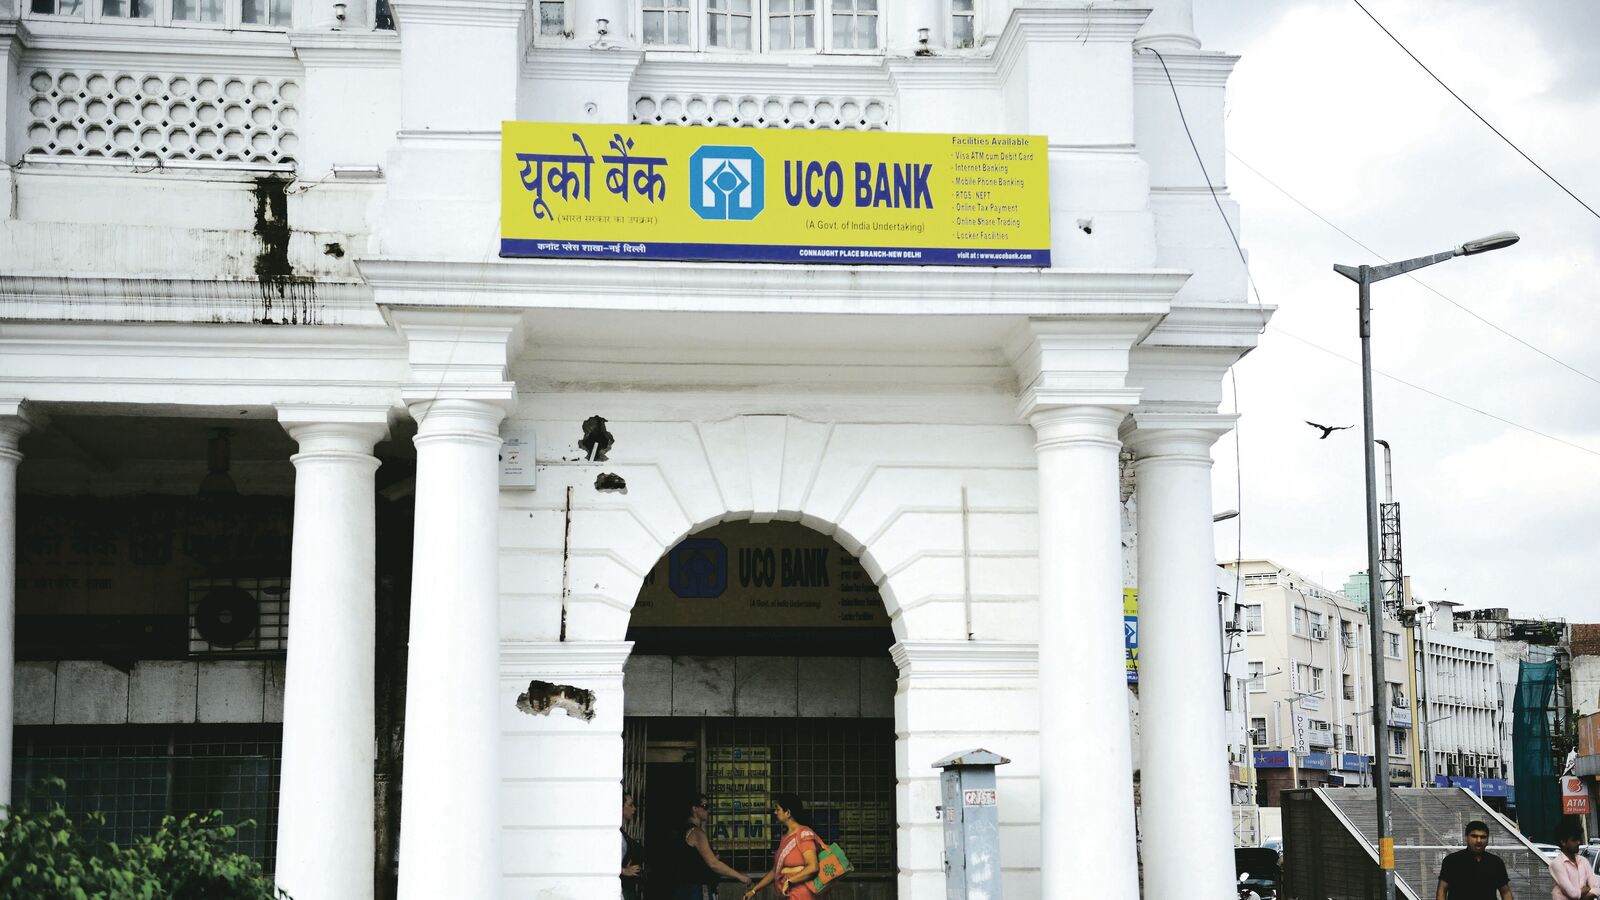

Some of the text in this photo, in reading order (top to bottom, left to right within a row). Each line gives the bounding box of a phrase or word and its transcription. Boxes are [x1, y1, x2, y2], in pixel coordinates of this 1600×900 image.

[952, 137, 1029, 146] Facilities Available
[955, 152, 969, 160] Visa
[971, 152, 984, 160] ATM
[1000, 152, 1017, 160] Debit
[1019, 152, 1033, 161] Card
[955, 164, 1008, 174] Internet Banking
[516, 133, 668, 221] यूको बैंक
[784, 160, 933, 209] UCO BANK
[955, 177, 1024, 188] Mobile Phone Banking
[976, 191, 991, 200] NEFT
[956, 203, 1018, 213] Online Tax Payment
[805, 219, 925, 233] (A Govt. of India Undertaking)
[956, 217, 1020, 228] Online Share Trading
[956, 231, 1008, 240] Locker Facilities
[623, 243, 646, 253] दिल्ली
[799, 249, 839, 257] CONNAUGHT
[839, 250, 860, 258] PLACE
[860, 250, 902, 258] BRANCH-NEW
[739, 548, 830, 587] UCO BANK
[1567, 799, 1586, 807] ATM
[714, 820, 763, 838] ATM
